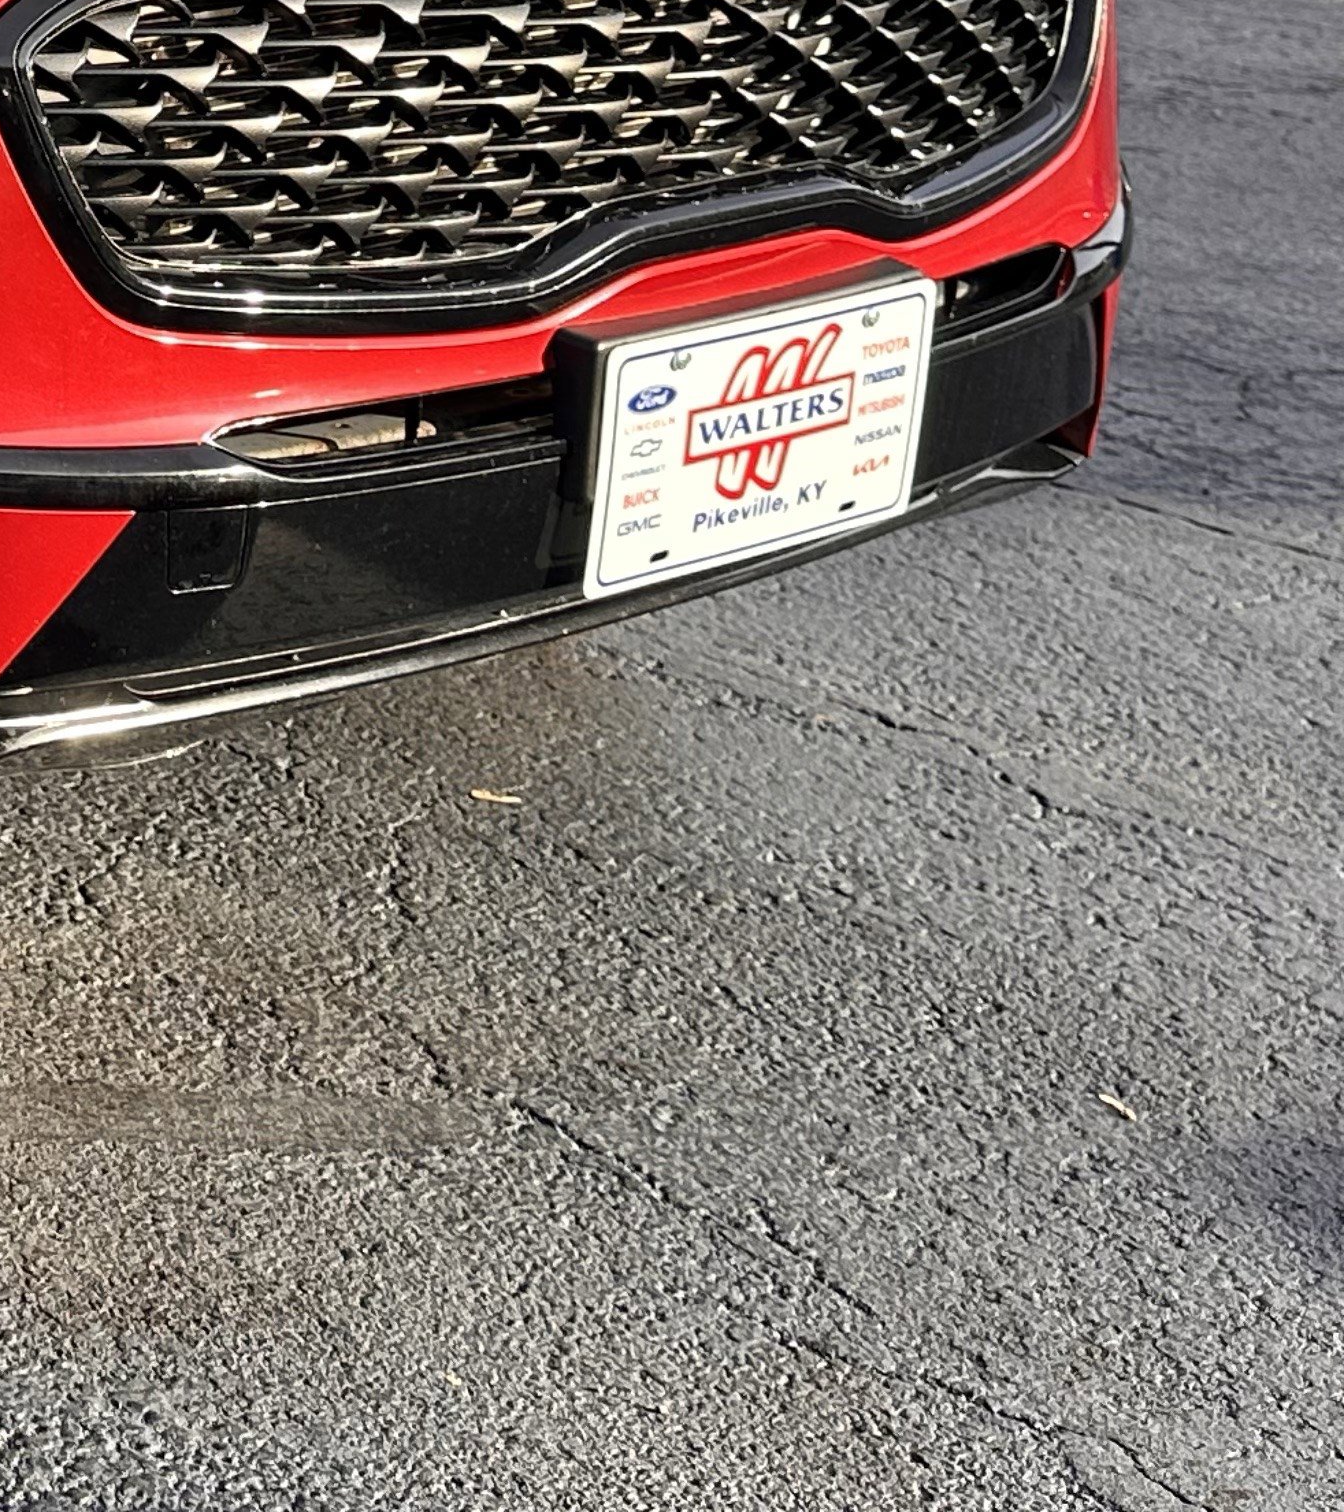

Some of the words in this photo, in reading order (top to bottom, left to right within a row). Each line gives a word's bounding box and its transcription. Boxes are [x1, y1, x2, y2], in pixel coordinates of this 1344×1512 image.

[862, 336, 910, 359] TOYOTA
[623, 416, 676, 436] LINCOLN
[699, 387, 844, 445] WALTERS
[854, 423, 902, 445] NISSAN
[622, 487, 661, 510] BUICK
[692, 492, 790, 533] Pikeville,
[796, 479, 828, 506] KY
[617, 513, 662, 537] GMC
